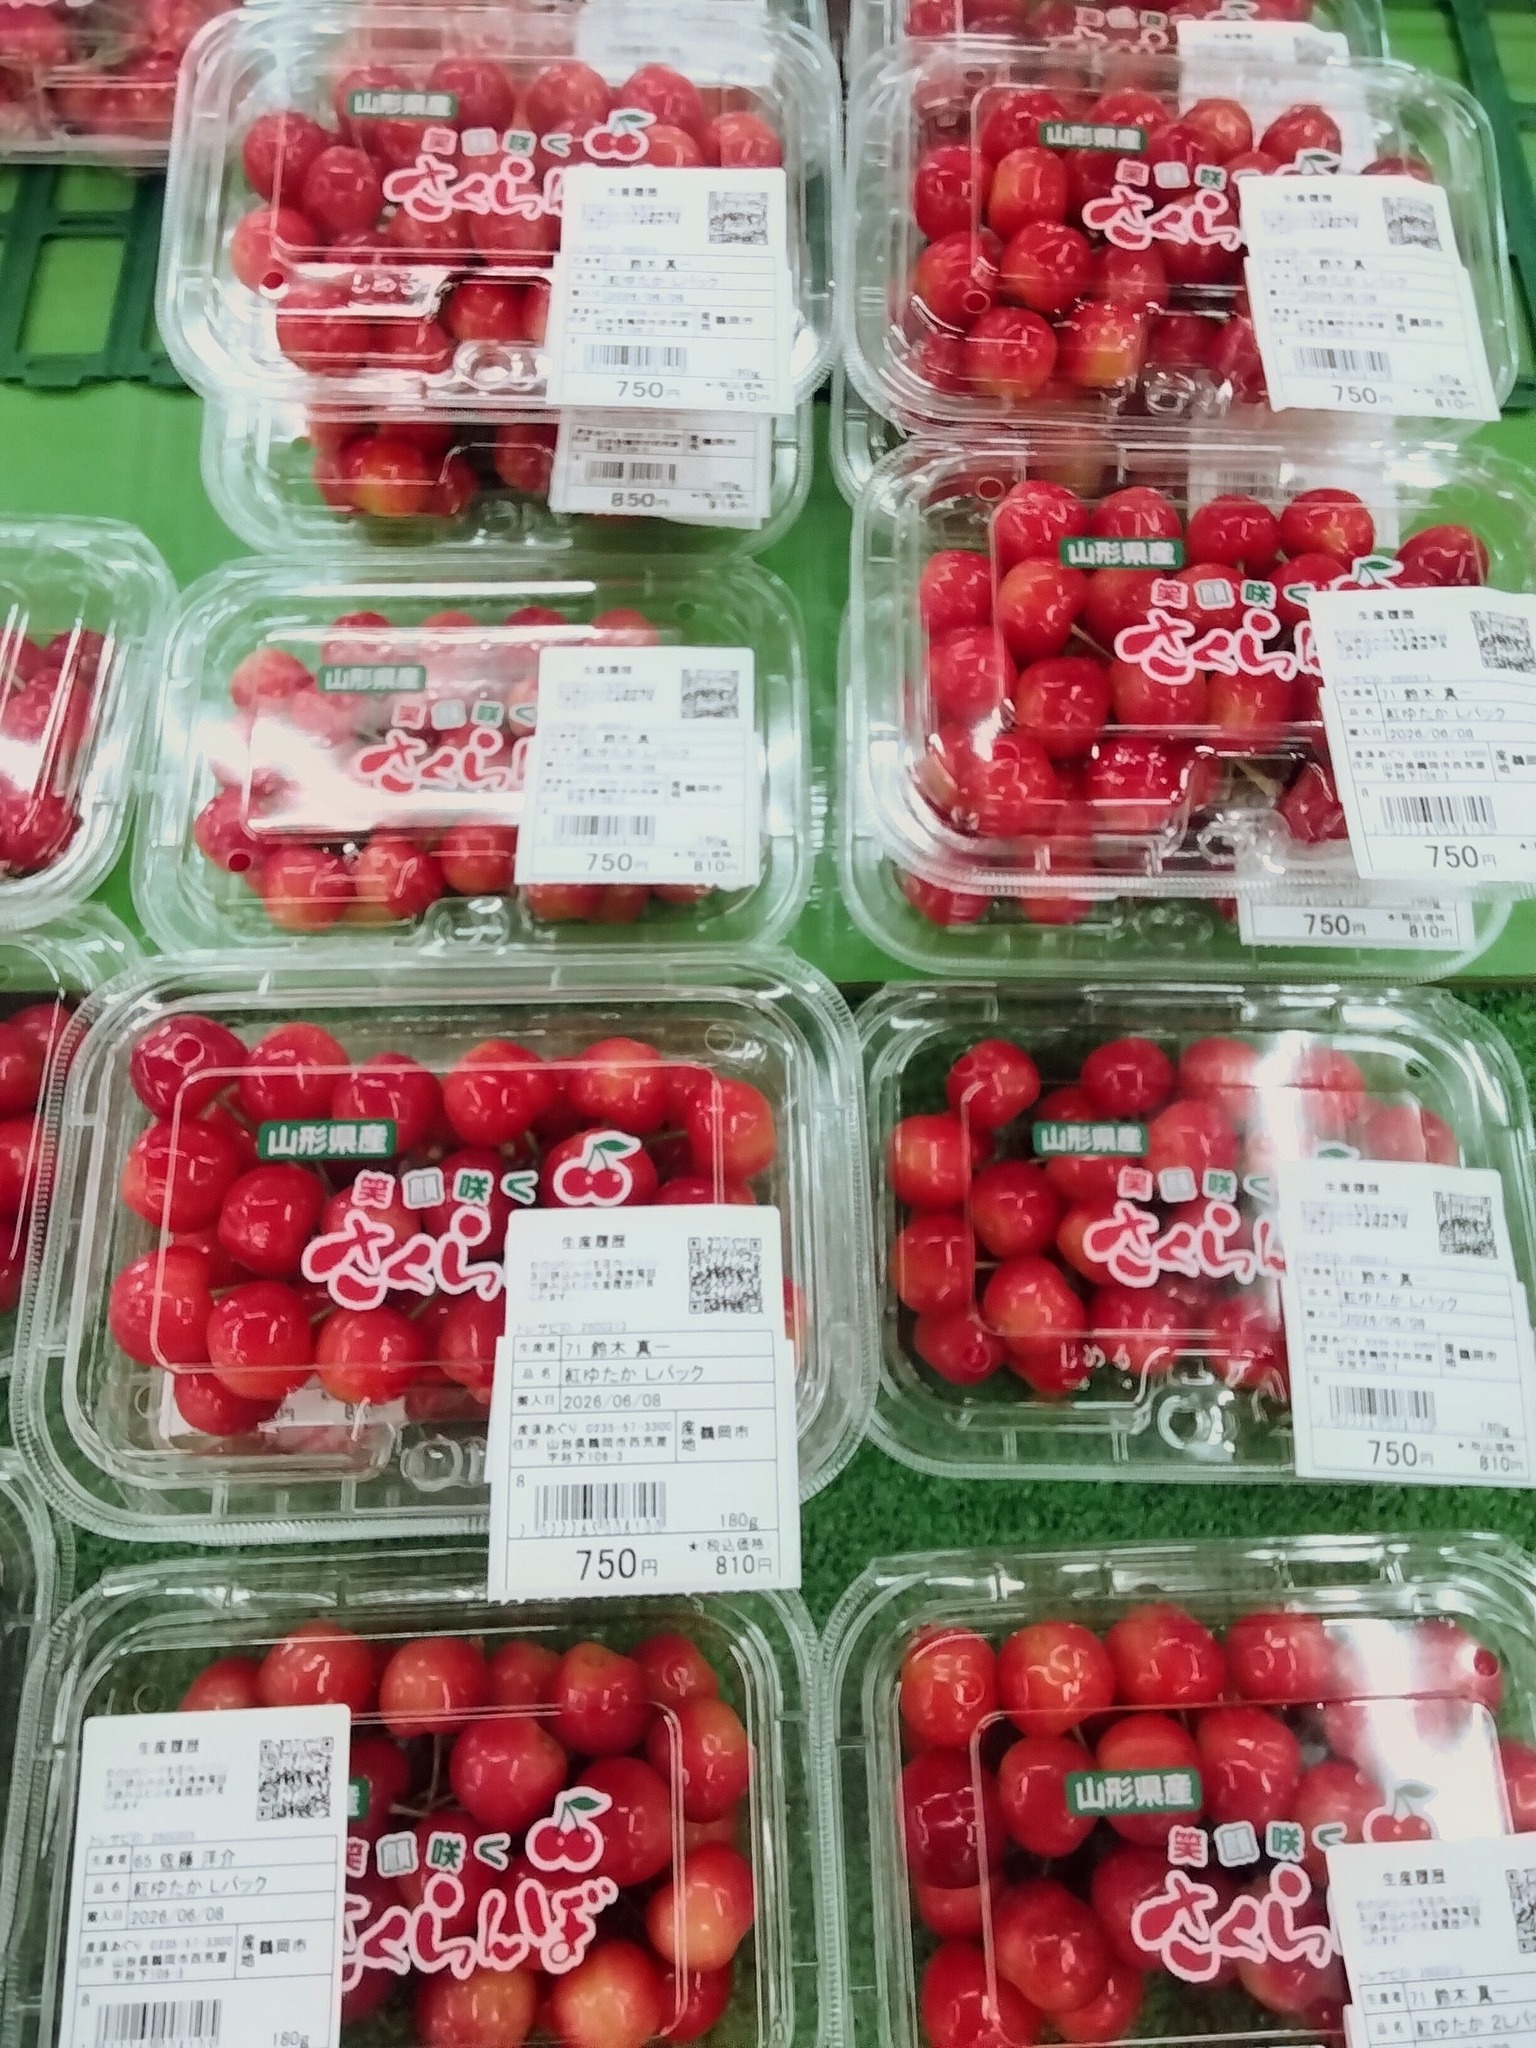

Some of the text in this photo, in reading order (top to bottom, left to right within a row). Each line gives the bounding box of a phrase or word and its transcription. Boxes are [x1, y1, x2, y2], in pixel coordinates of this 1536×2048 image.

[1067, 540, 1176, 566] 山形県産
[1425, 844, 1497, 869] 750円
[1303, 913, 1366, 936] 750円
[267, 1124, 388, 1157] 山形県産
[565, 1368, 637, 1385] 紅ゆたか
[1368, 1439, 1434, 1467] 750円
[576, 1548, 658, 1581] 750円
[715, 1554, 773, 1576] 810円
[1075, 1773, 1194, 1810] 山形県産
